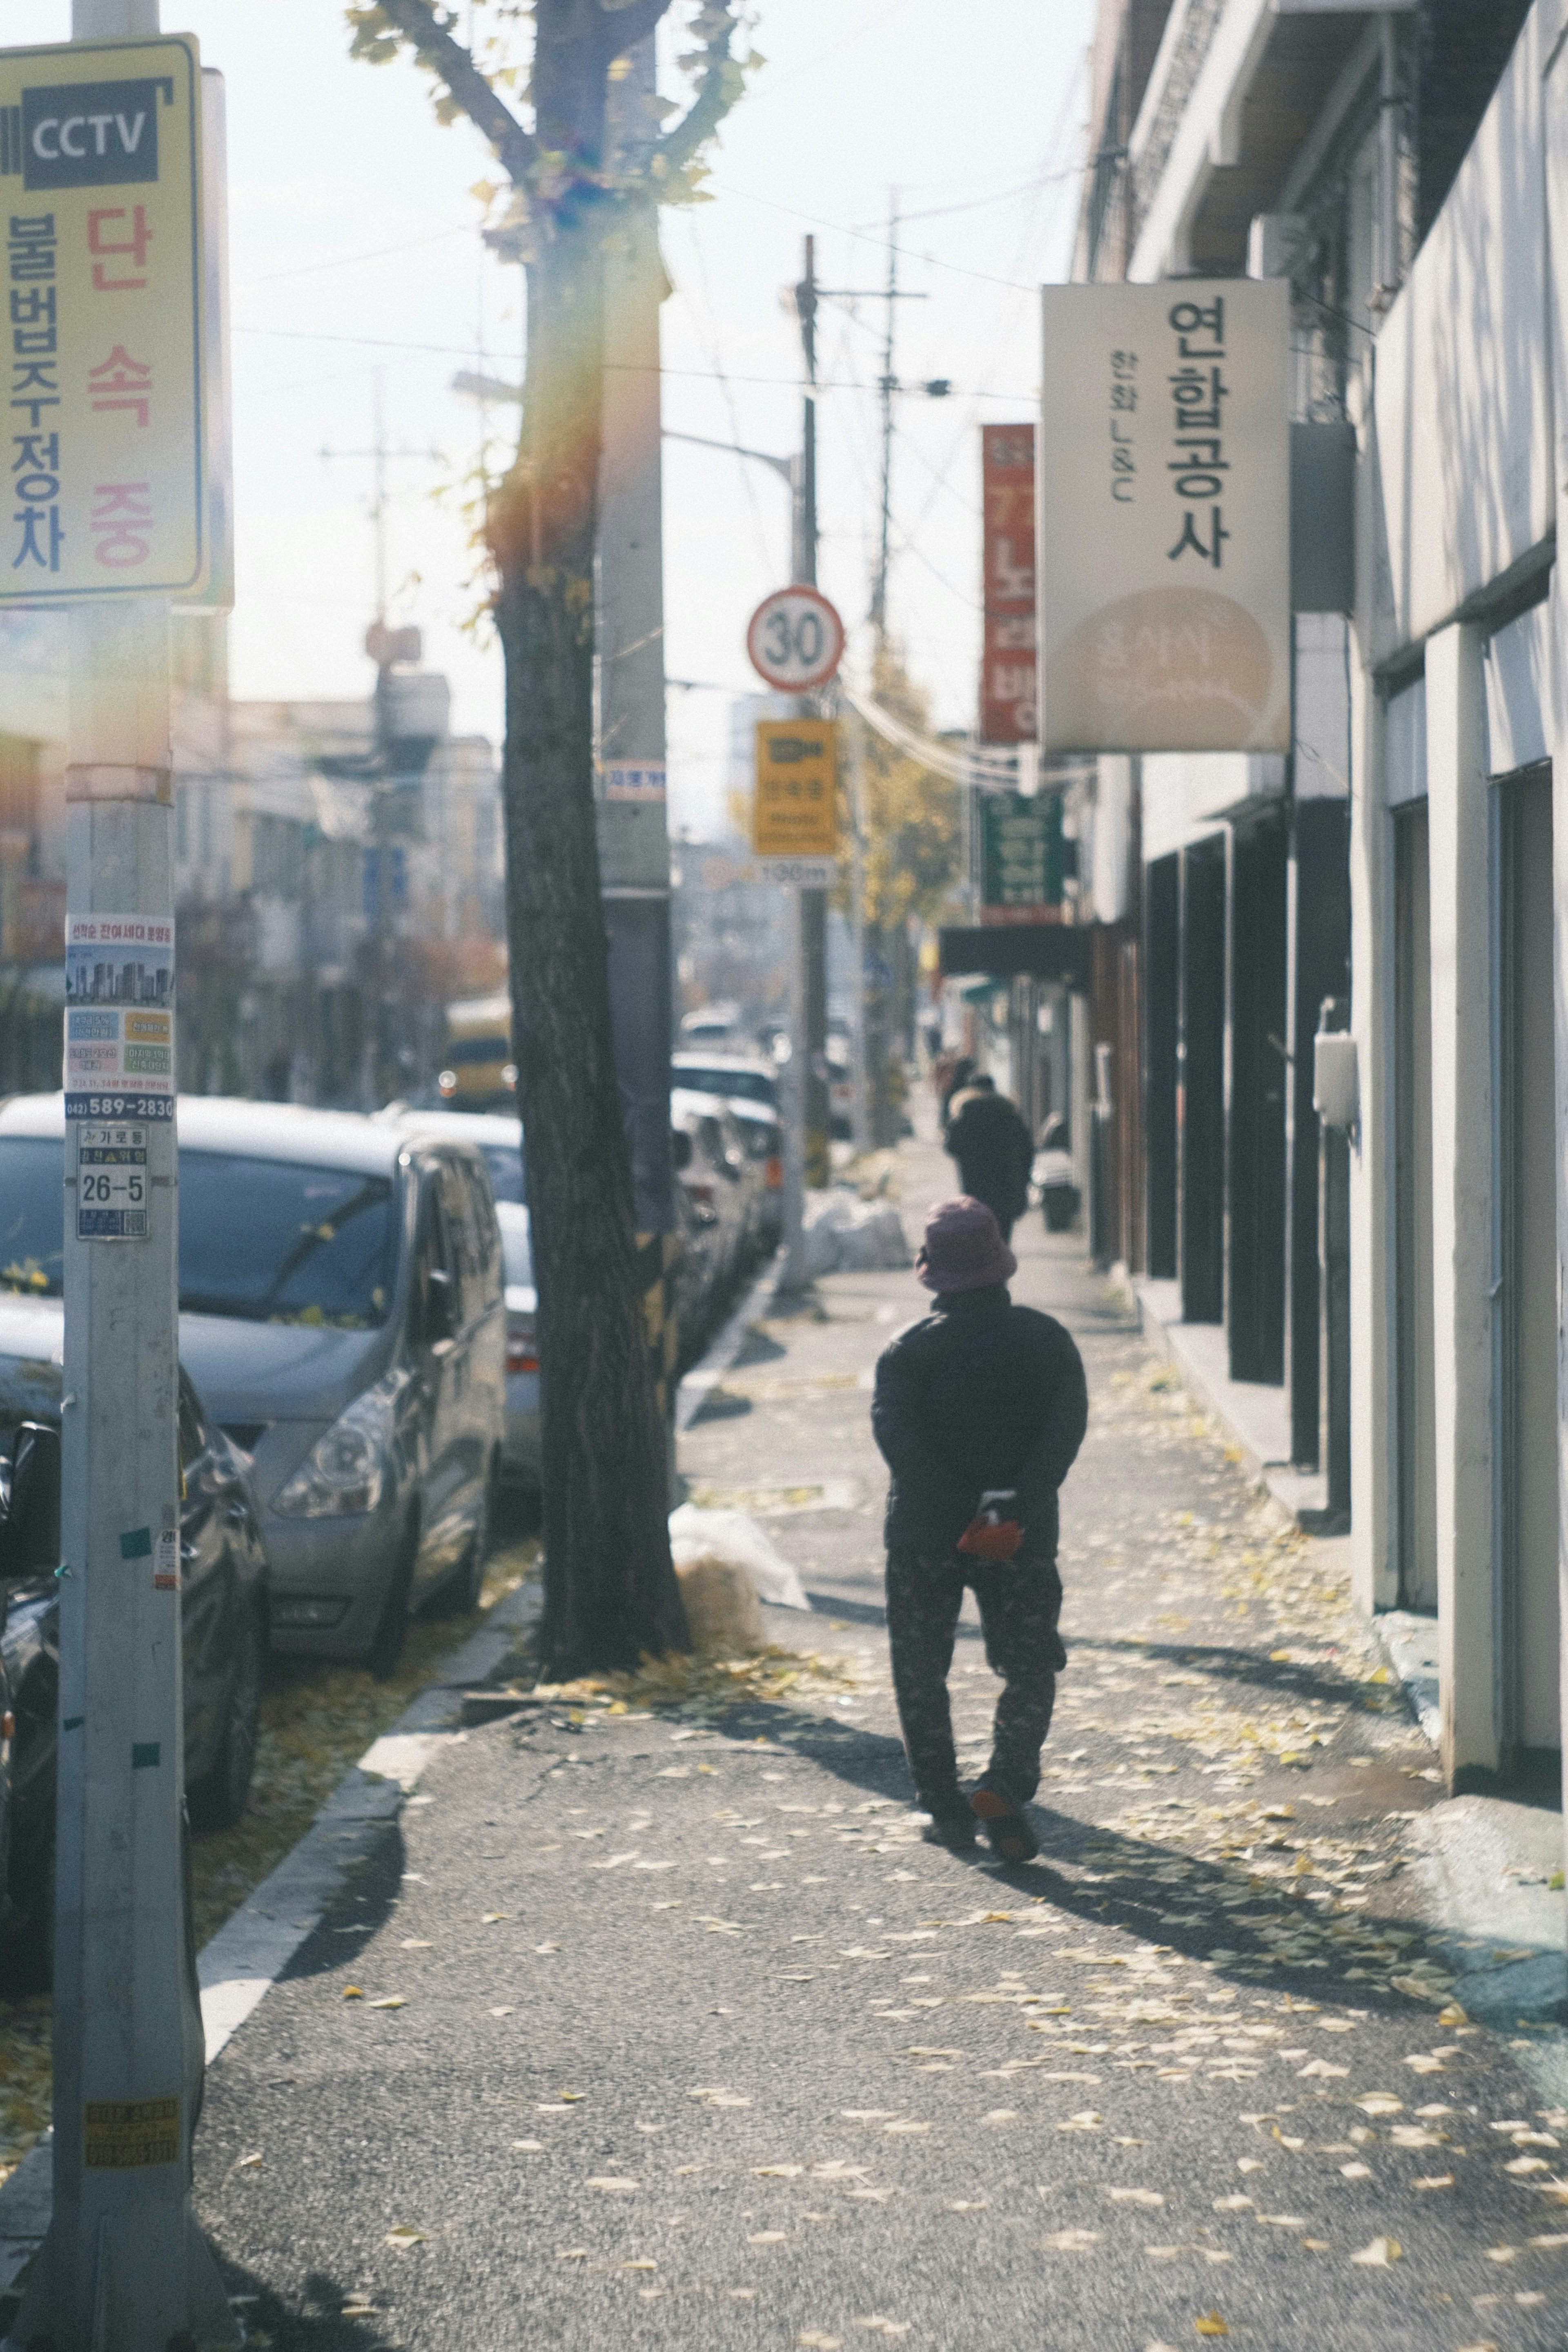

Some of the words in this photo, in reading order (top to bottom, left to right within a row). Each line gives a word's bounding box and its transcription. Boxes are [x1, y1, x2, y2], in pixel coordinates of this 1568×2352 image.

[32, 112, 145, 160] CCTV
[7, 213, 65, 572] 불법주정차
[1167, 294, 1230, 568] 연합공사
[764, 610, 824, 666] 30
[100, 1131, 142, 1145] 가로등
[83, 1175, 143, 1202] 26-5
